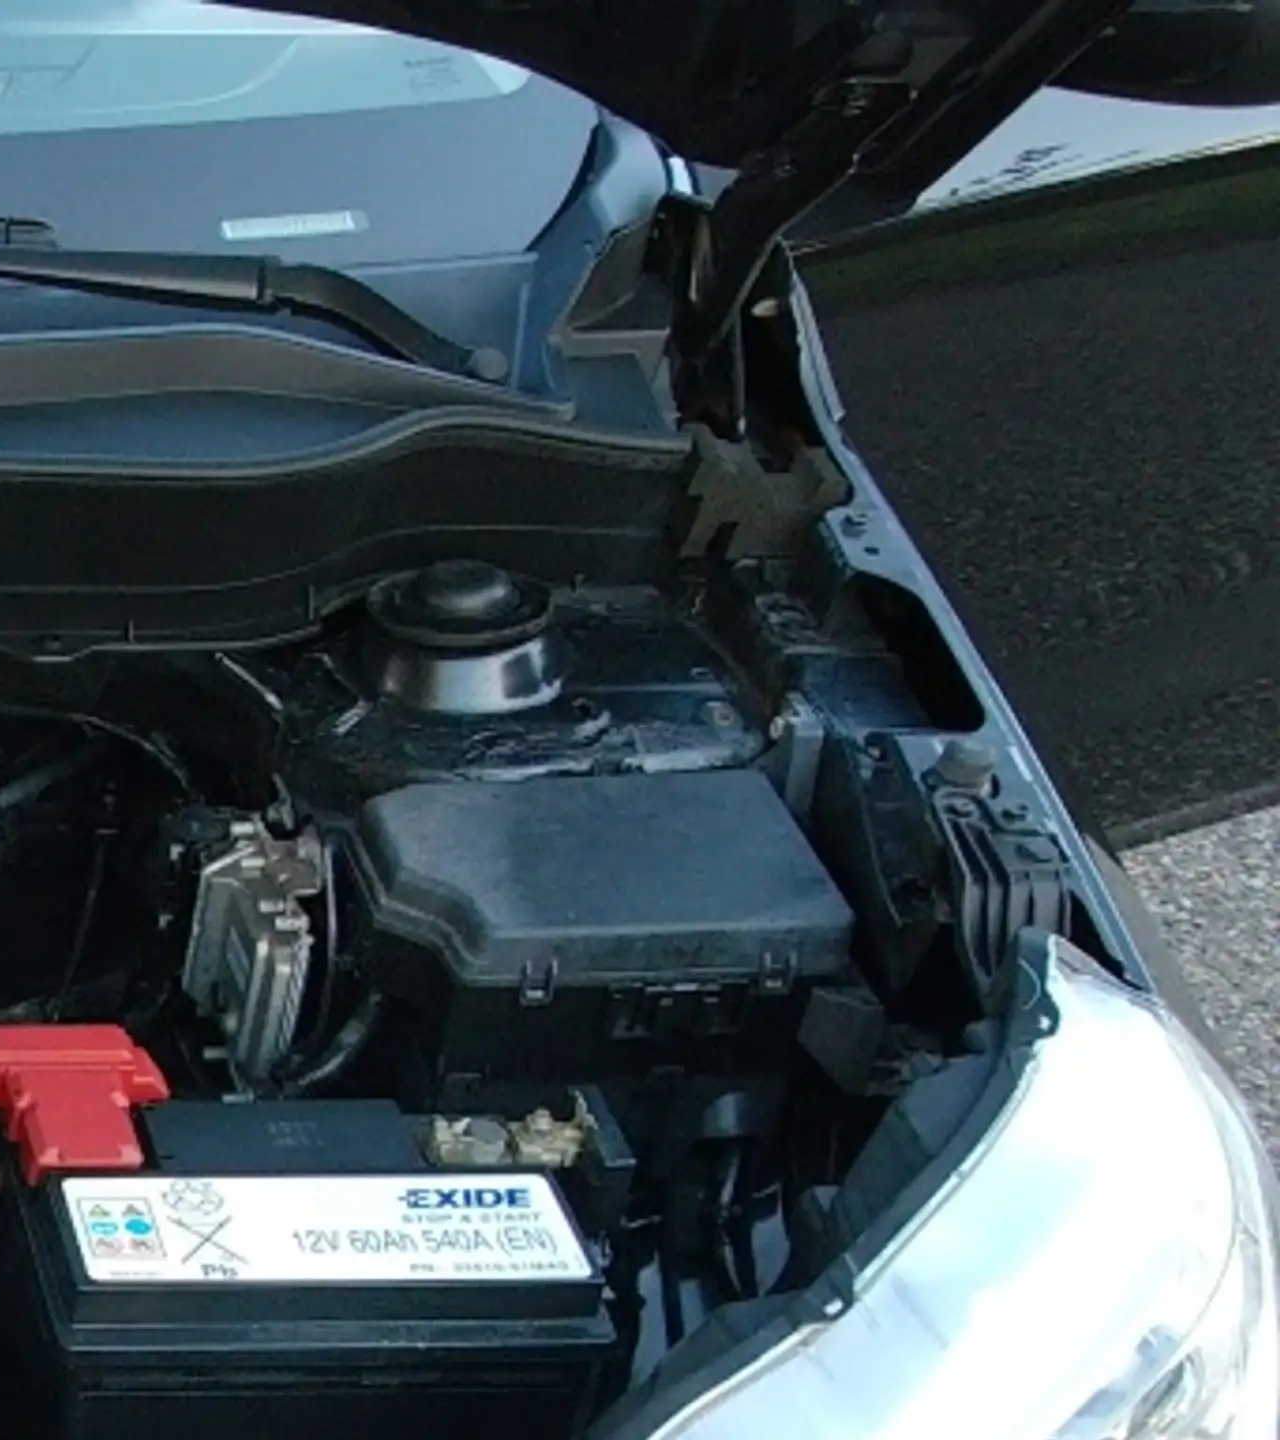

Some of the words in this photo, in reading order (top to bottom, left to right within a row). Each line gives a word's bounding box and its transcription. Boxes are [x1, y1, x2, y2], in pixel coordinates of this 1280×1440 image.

[398, 1188, 532, 1209] EXIDE
[292, 1230, 340, 1254] 12V
[347, 1229, 418, 1254] 60Ah
[421, 1228, 493, 1253] 540A
[496, 1226, 558, 1257] (EN)
